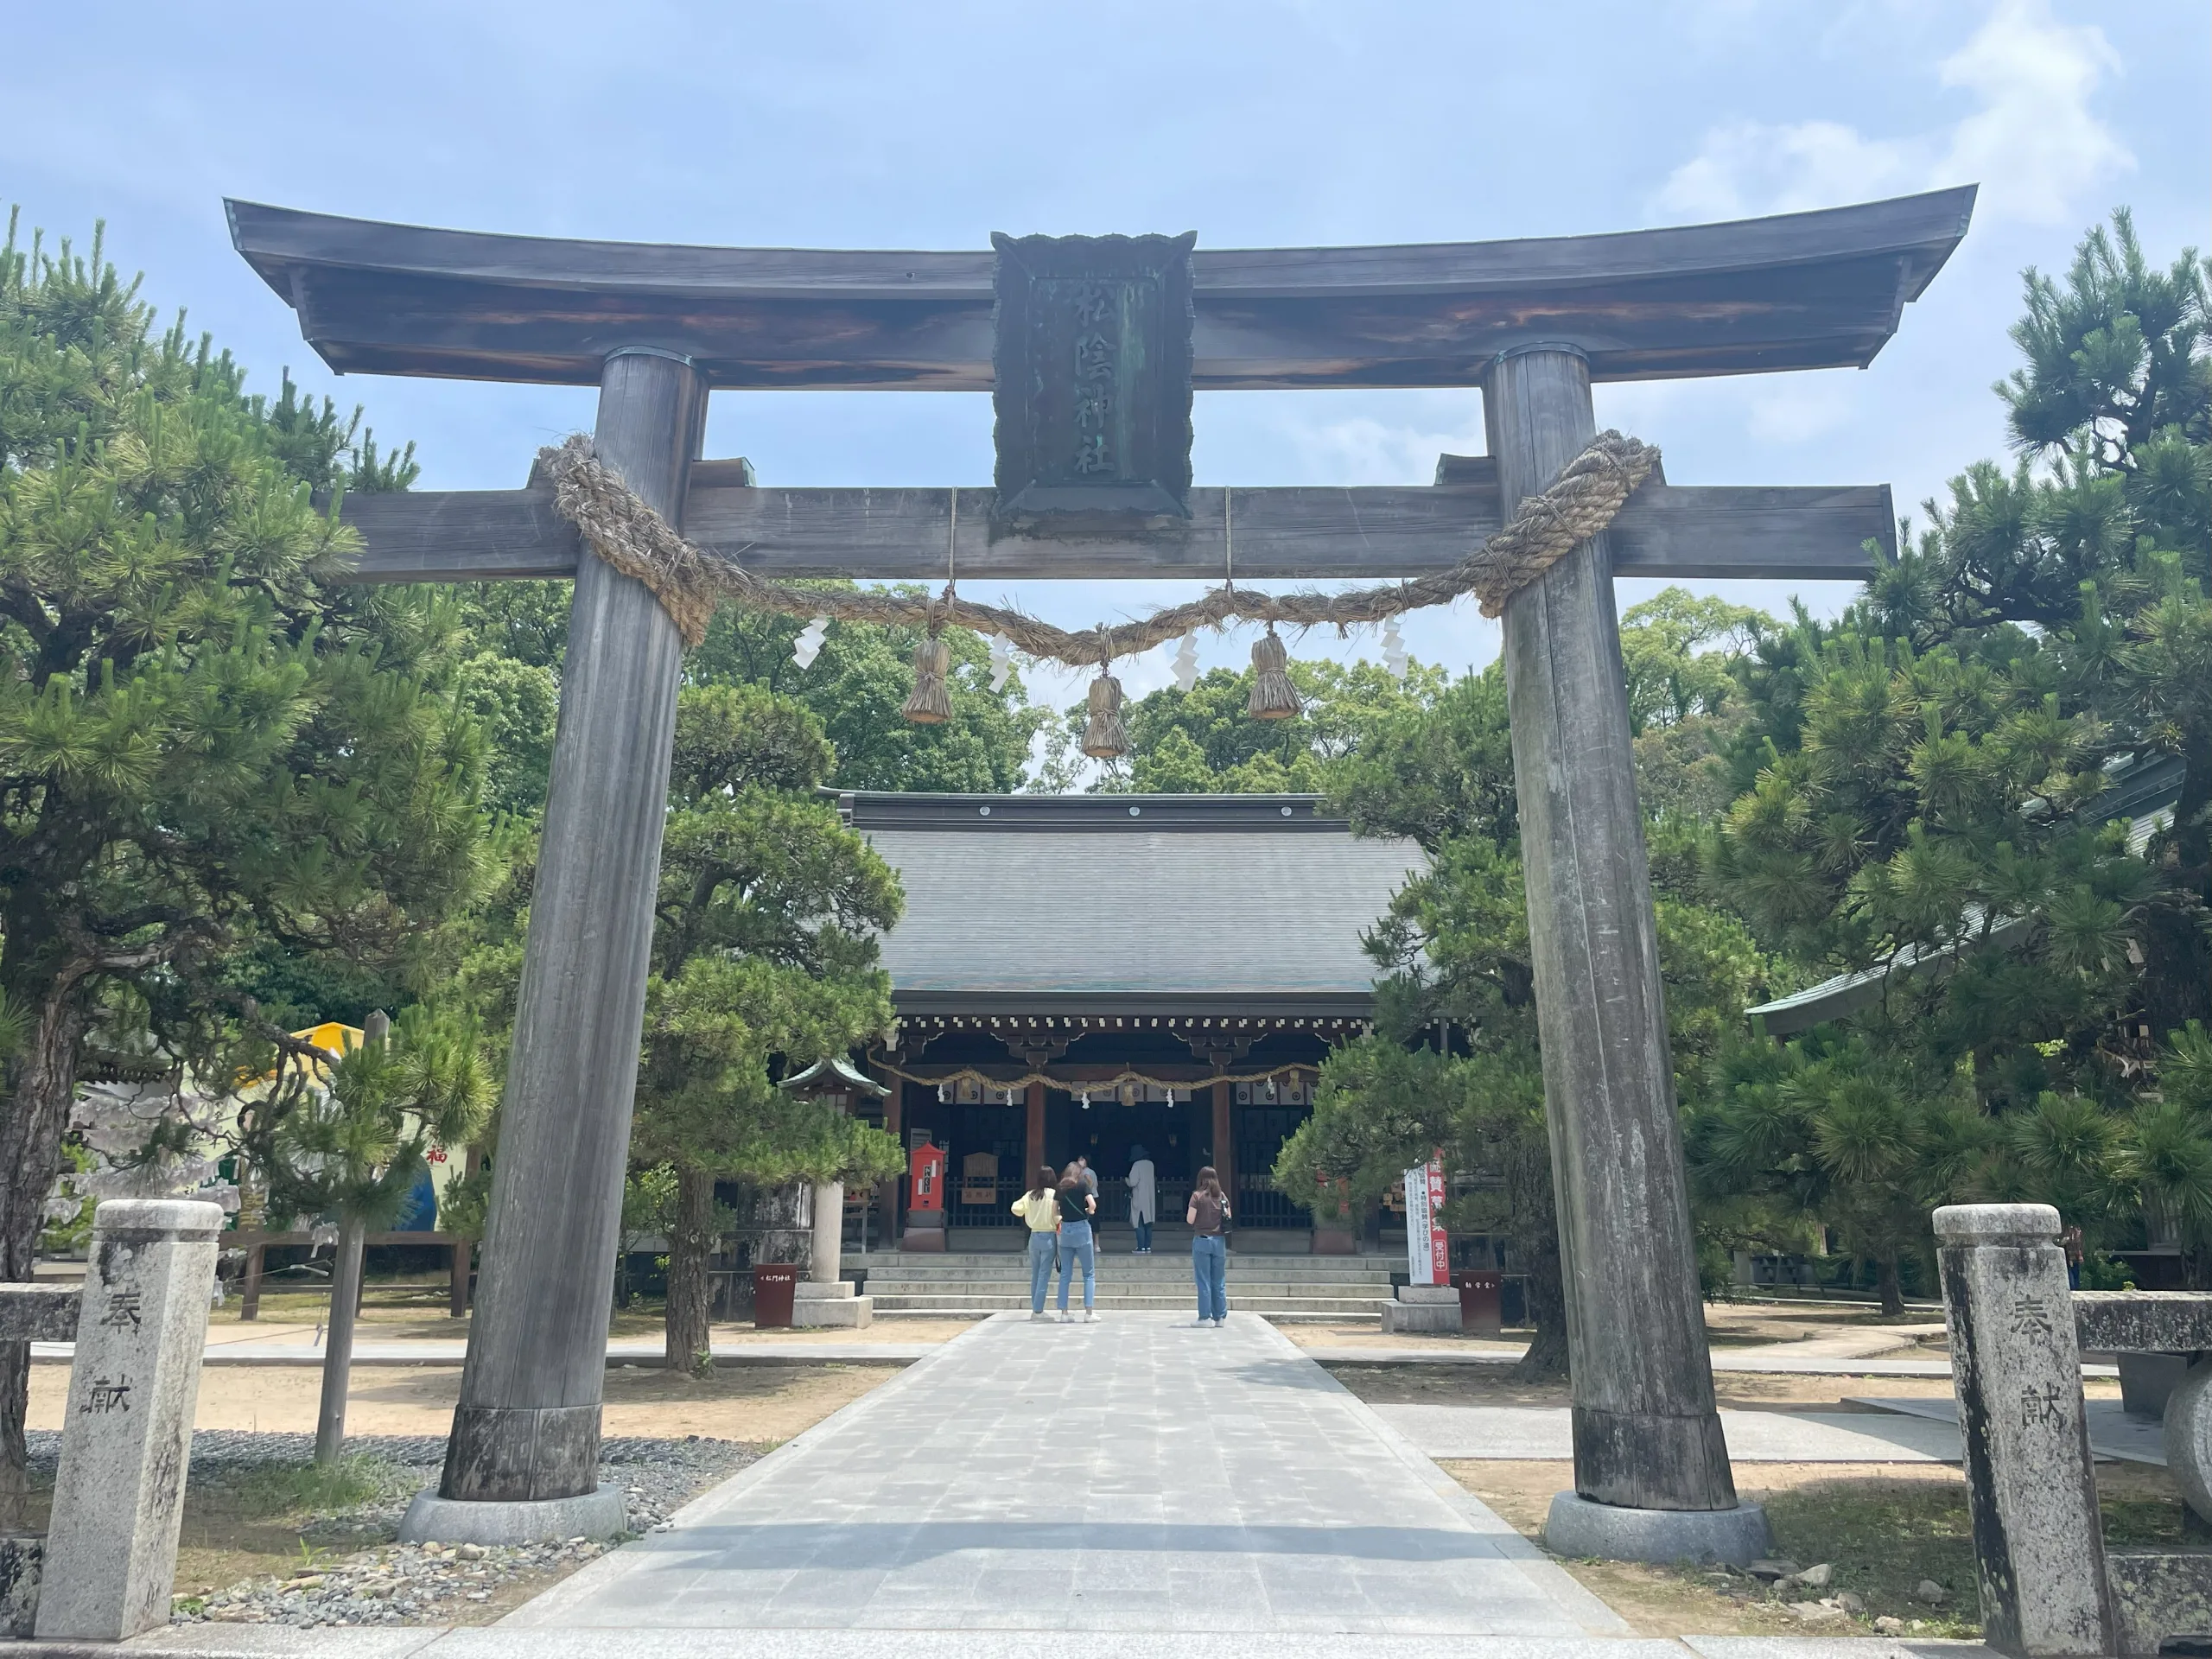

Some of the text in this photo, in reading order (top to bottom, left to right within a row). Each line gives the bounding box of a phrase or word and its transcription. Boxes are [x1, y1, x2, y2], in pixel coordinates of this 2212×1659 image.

[1073, 284, 1118, 474] 松陰神社
[426, 1142, 448, 1165] 福
[1434, 1242, 1446, 1269] 受付中
[79, 1290, 142, 1414] 奉献
[2010, 1294, 2065, 1430] 奉献
